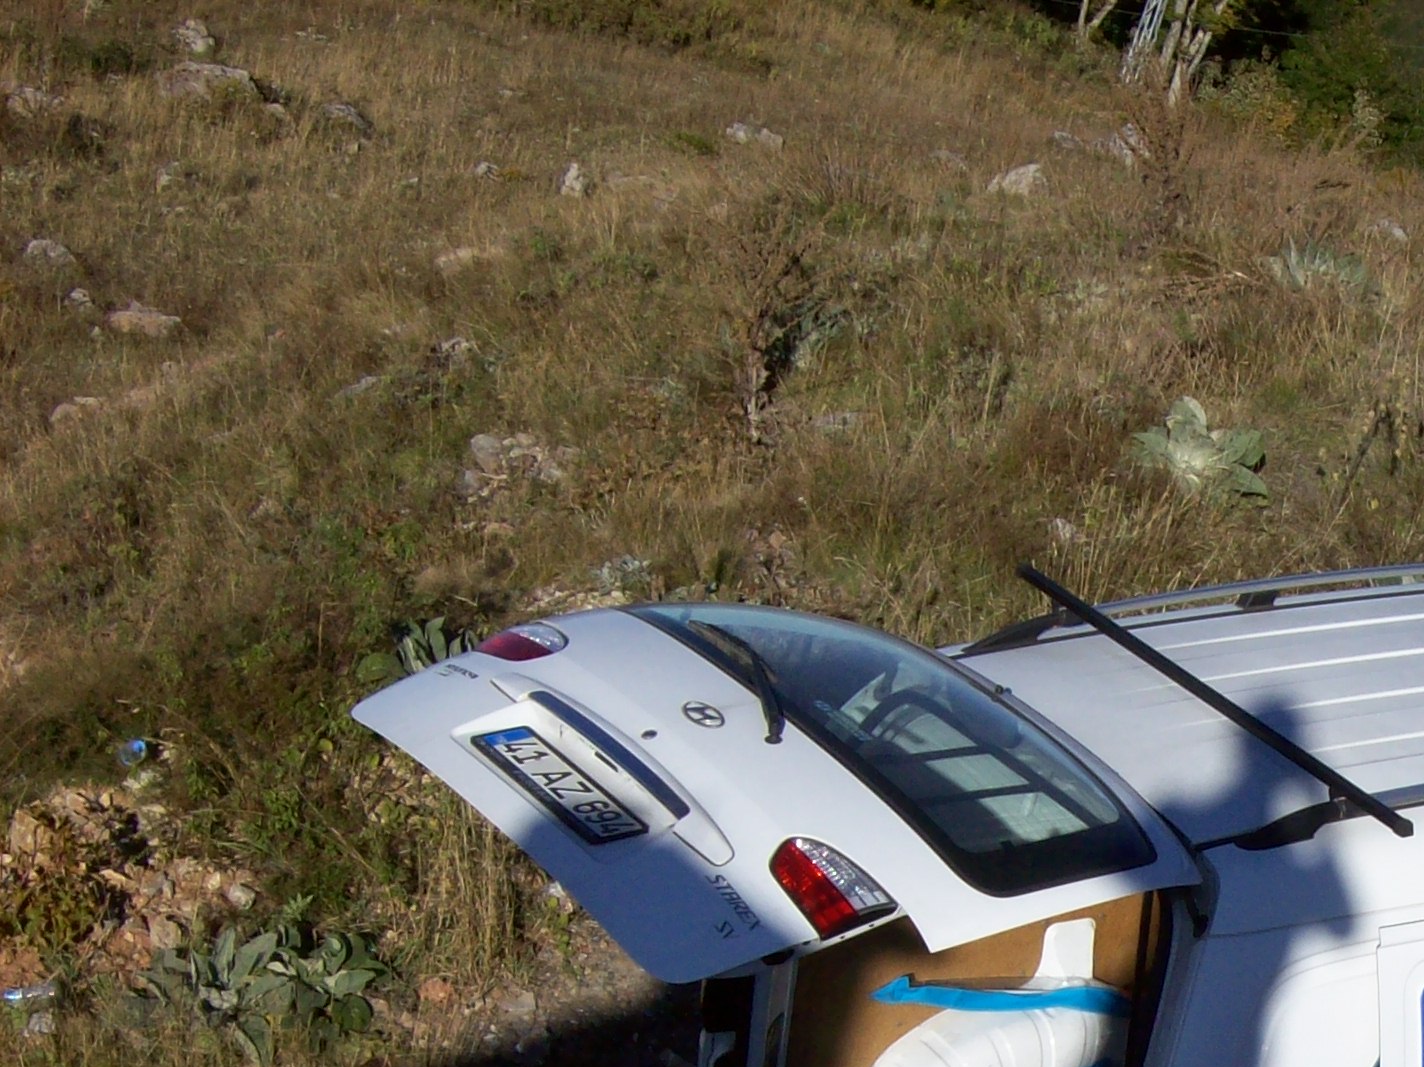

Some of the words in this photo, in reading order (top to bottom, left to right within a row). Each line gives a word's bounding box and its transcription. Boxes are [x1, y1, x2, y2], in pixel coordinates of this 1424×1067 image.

[504, 742, 549, 764] 41
[531, 772, 594, 799] AZ
[573, 801, 634, 836] 694
[704, 874, 763, 931] STAREX
